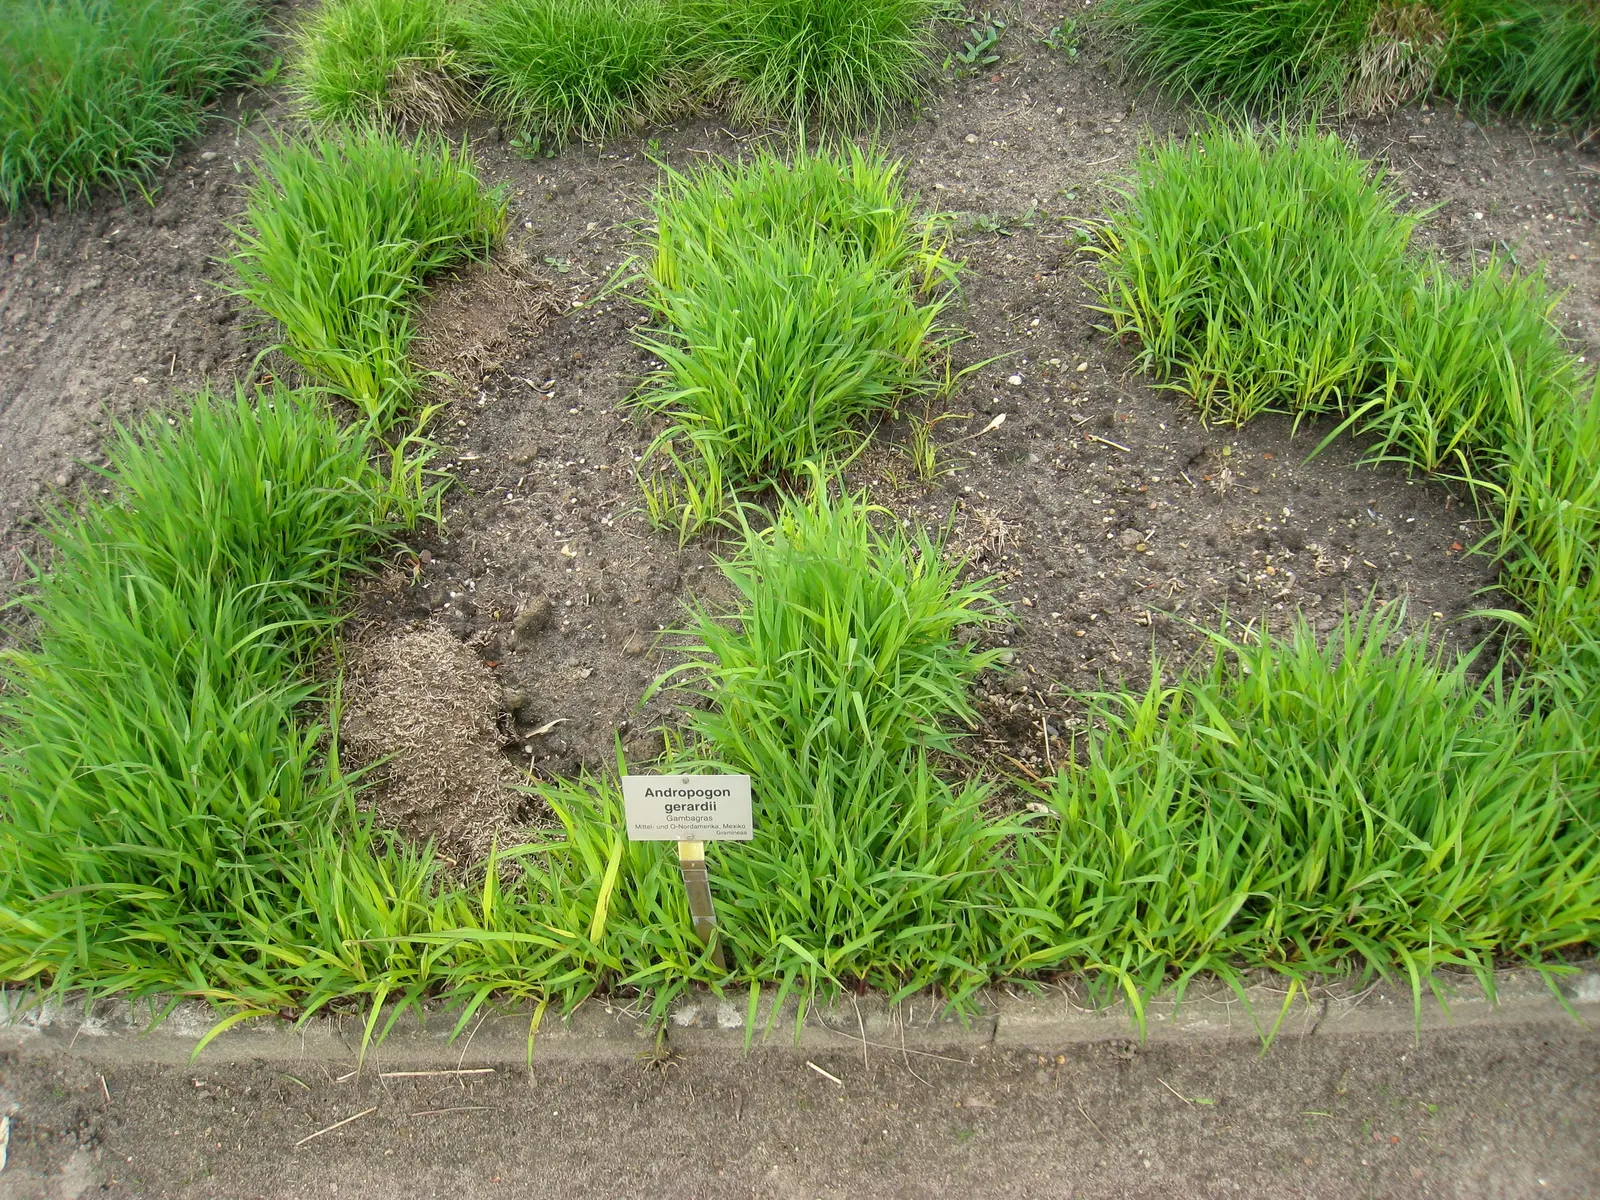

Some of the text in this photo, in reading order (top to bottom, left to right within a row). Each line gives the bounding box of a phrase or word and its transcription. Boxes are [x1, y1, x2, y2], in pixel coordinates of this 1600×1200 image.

[645, 788, 731, 800] Andropogon
[664, 801, 717, 814] gerardii
[666, 815, 713, 823] Gambagras
